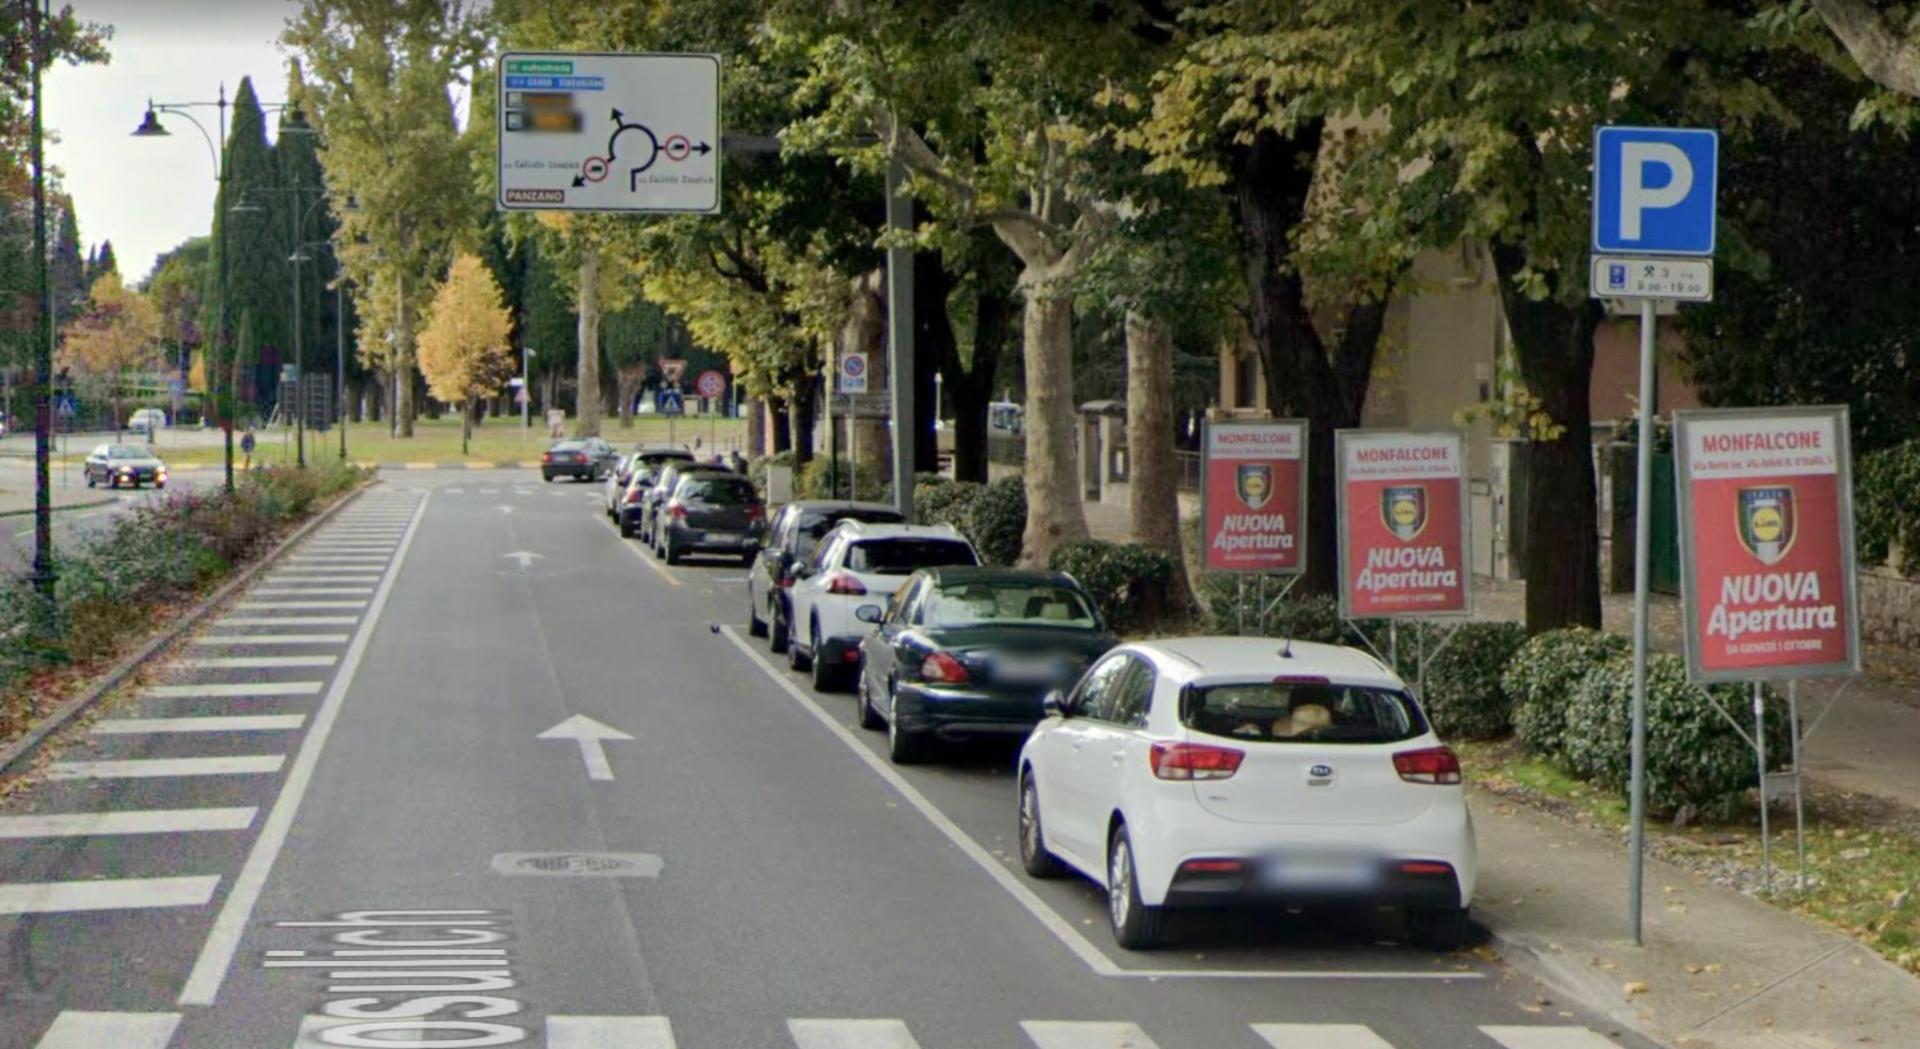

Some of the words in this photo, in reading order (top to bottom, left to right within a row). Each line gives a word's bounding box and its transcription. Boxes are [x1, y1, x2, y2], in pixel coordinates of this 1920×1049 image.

[508, 191, 562, 200] PANZANO
[1619, 141, 1694, 240] P
[1217, 433, 1292, 445] MONFALCONE
[1702, 430, 1822, 453] MONFALCONE
[1357, 447, 1448, 463] MONFALCONE
[1223, 514, 1284, 531] NUOVA
[1214, 531, 1293, 551] Apertura
[1367, 547, 1445, 568] NUOVA
[1356, 567, 1457, 591] Apertura
[1721, 571, 1820, 605] NUOVA
[1707, 603, 1837, 641] Apertura
